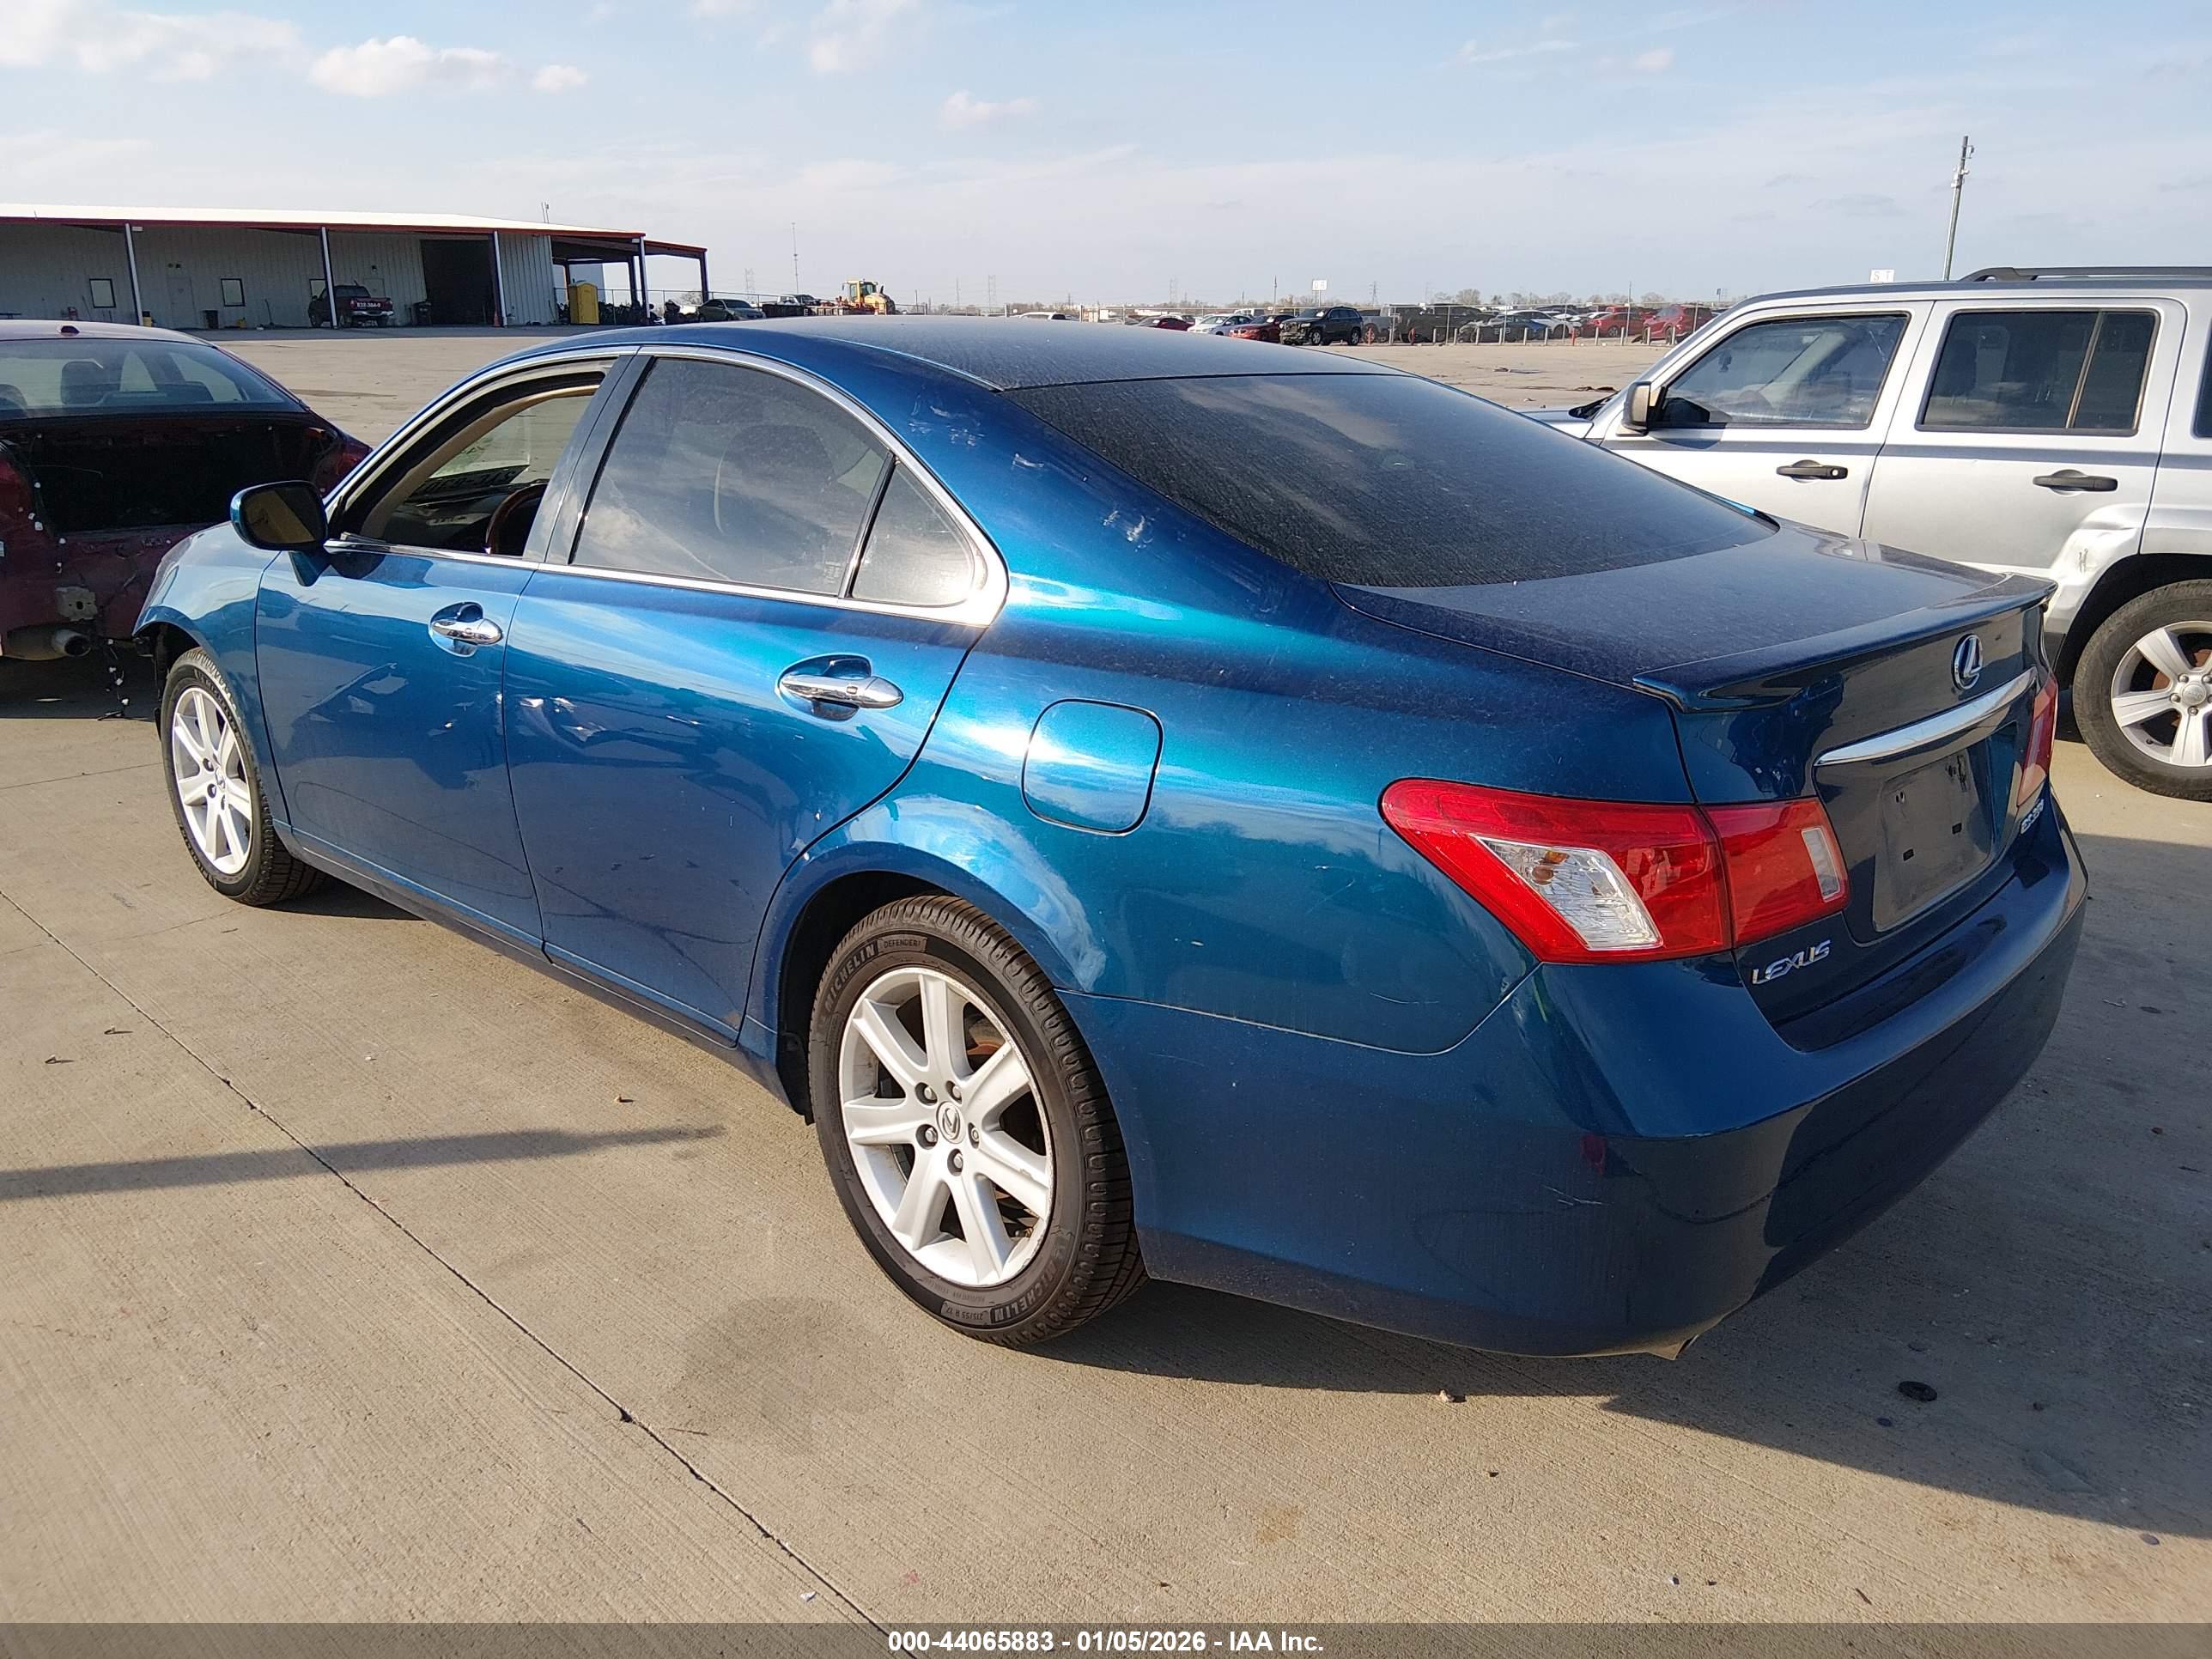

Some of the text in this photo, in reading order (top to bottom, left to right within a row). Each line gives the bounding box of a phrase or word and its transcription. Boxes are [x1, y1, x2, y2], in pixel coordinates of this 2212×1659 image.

[824, 943, 876, 1012] MICHELIN
[1752, 939, 1832, 985] LEXUS
[994, 1260, 1060, 1322] MICHELIN
